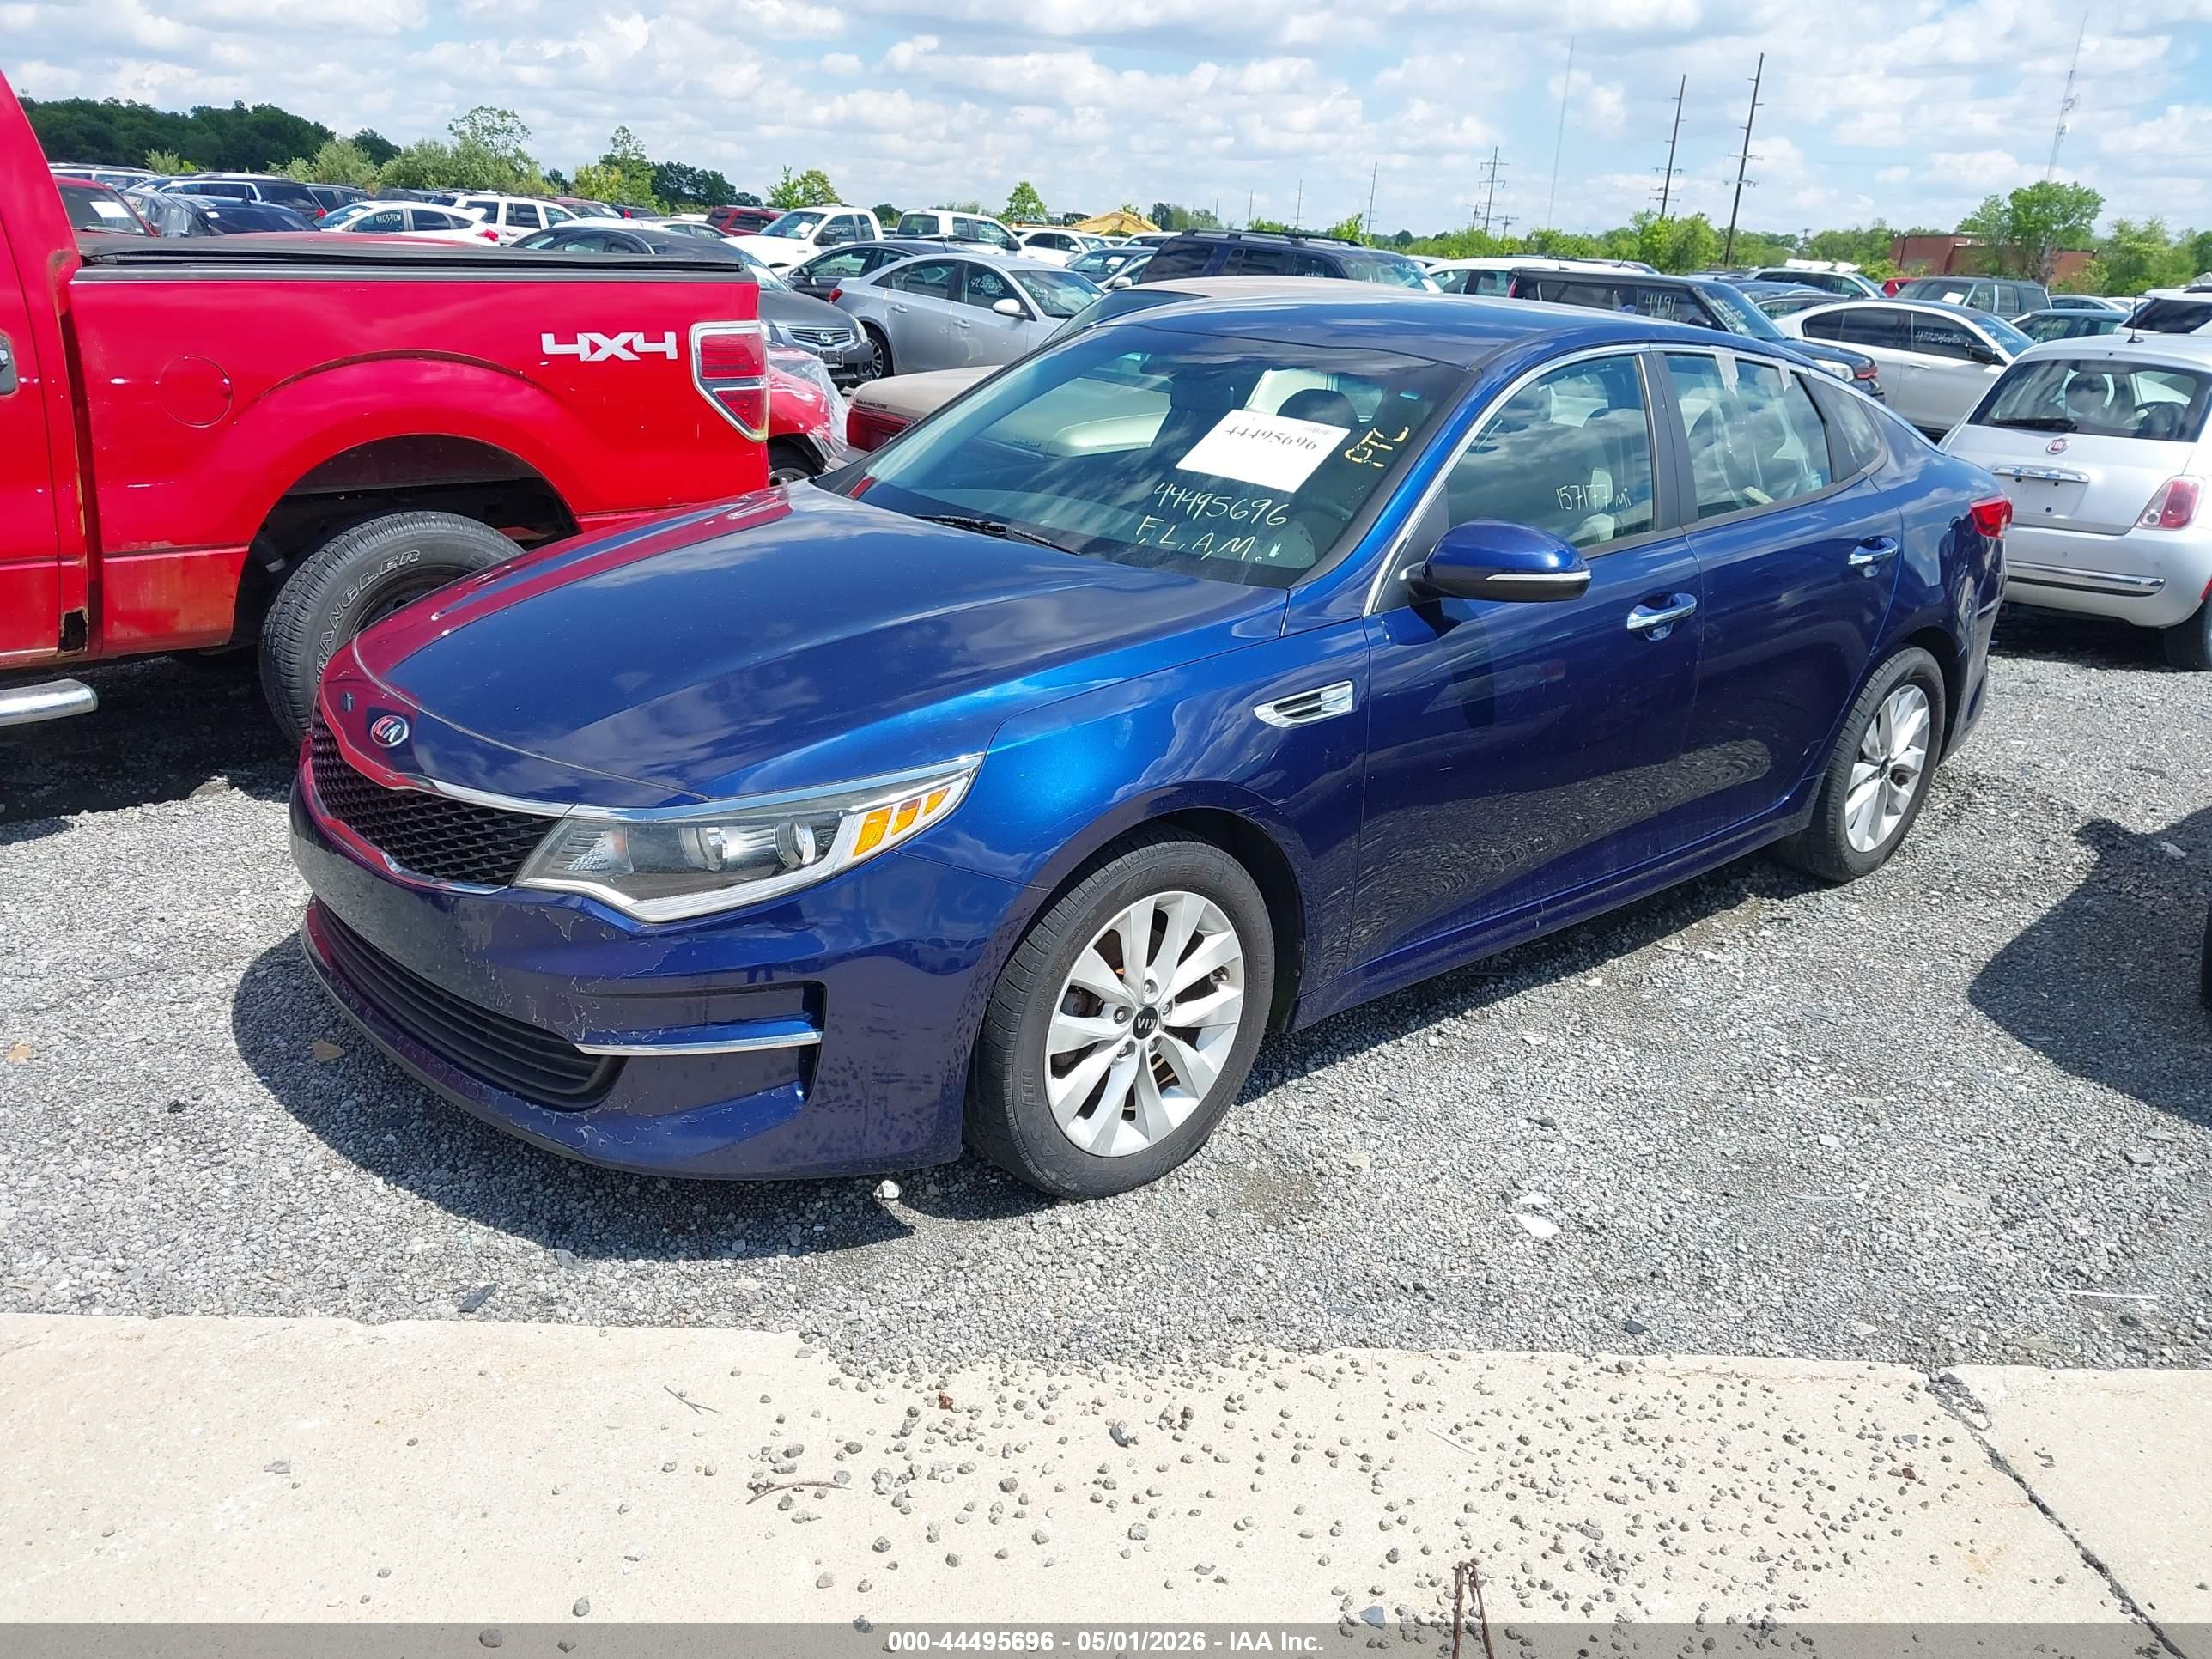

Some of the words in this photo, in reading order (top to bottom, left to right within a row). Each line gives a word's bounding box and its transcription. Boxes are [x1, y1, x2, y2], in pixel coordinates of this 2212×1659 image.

[541, 331, 678, 362] 4X4
[1153, 482, 1290, 526] 44495696
[1555, 484, 1608, 511] 157177
[1137, 1017, 1157, 1030] KIA
